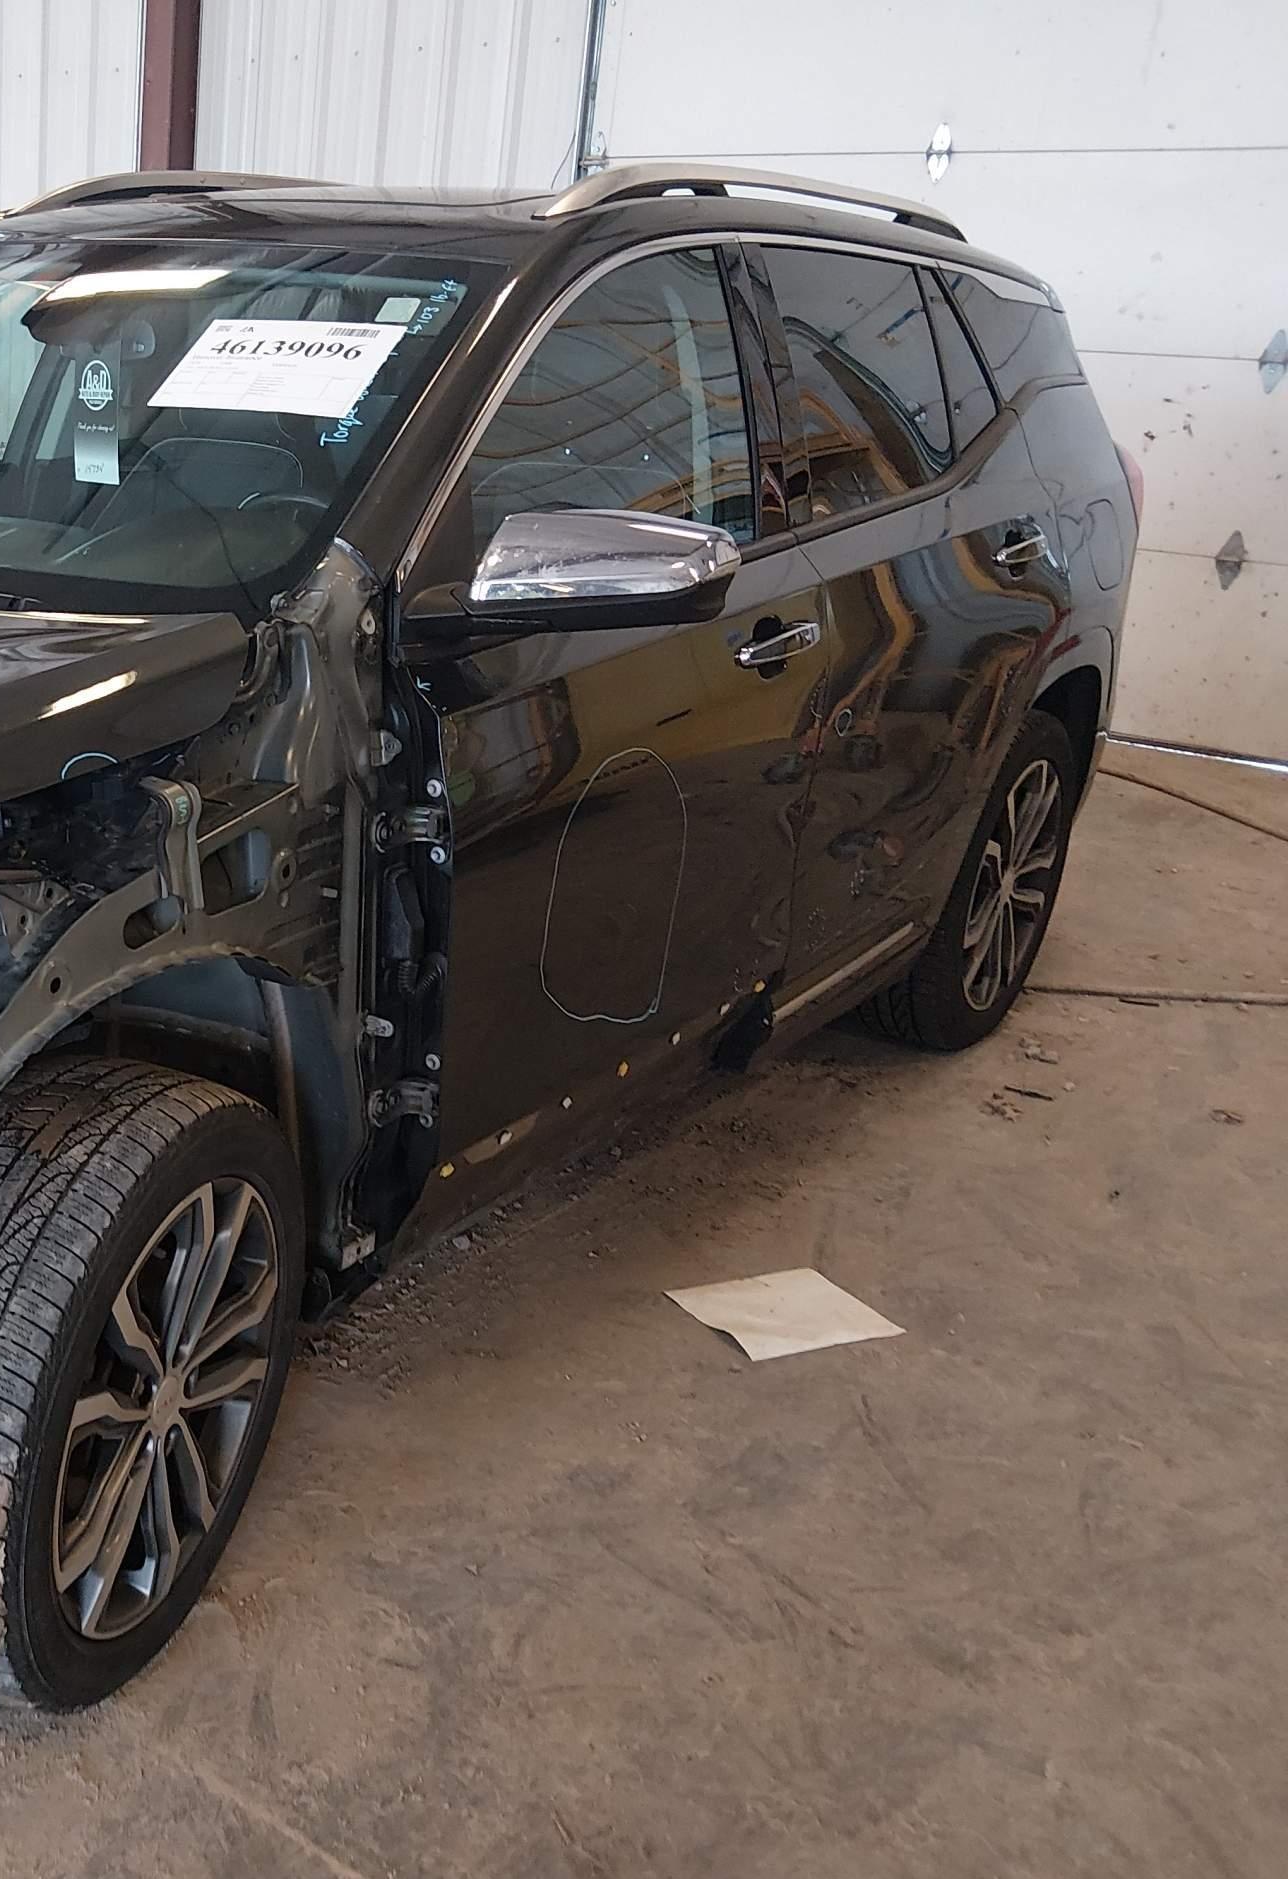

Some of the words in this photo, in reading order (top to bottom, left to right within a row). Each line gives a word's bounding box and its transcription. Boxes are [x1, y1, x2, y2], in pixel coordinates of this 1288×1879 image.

[417, 306, 441, 324] 103
[210, 338, 368, 361] 46139096
[86, 370, 107, 390] A&D
